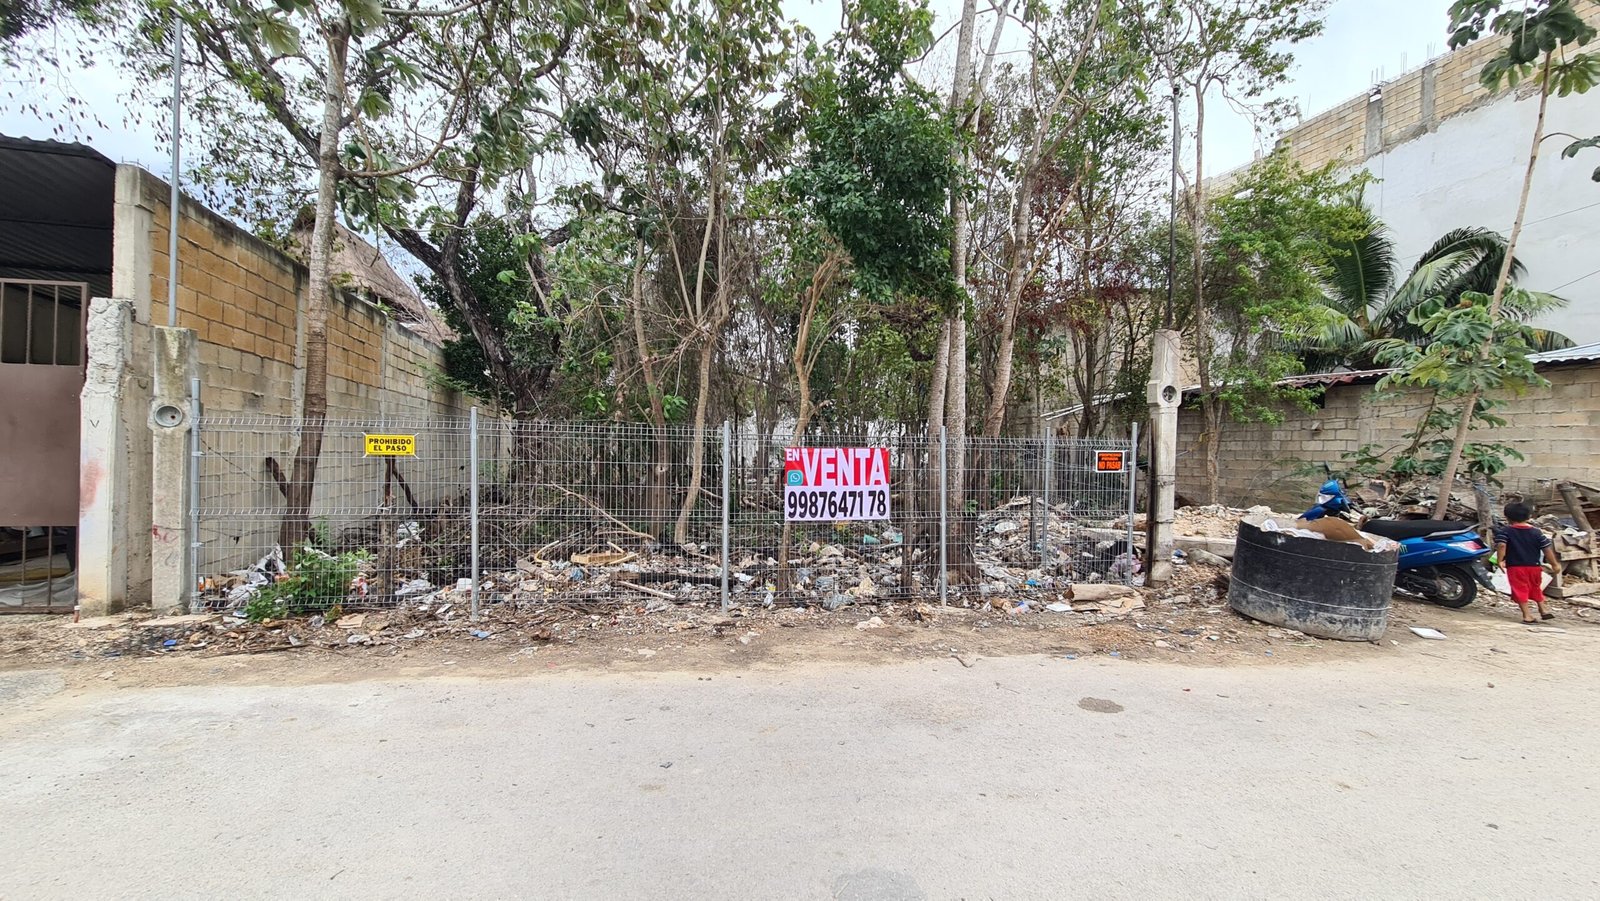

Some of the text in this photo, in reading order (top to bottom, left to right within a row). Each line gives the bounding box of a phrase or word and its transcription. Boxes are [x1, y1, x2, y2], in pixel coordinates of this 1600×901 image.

[786, 447, 887, 486] EN VENTA
[788, 490, 887, 518] 9987647178
